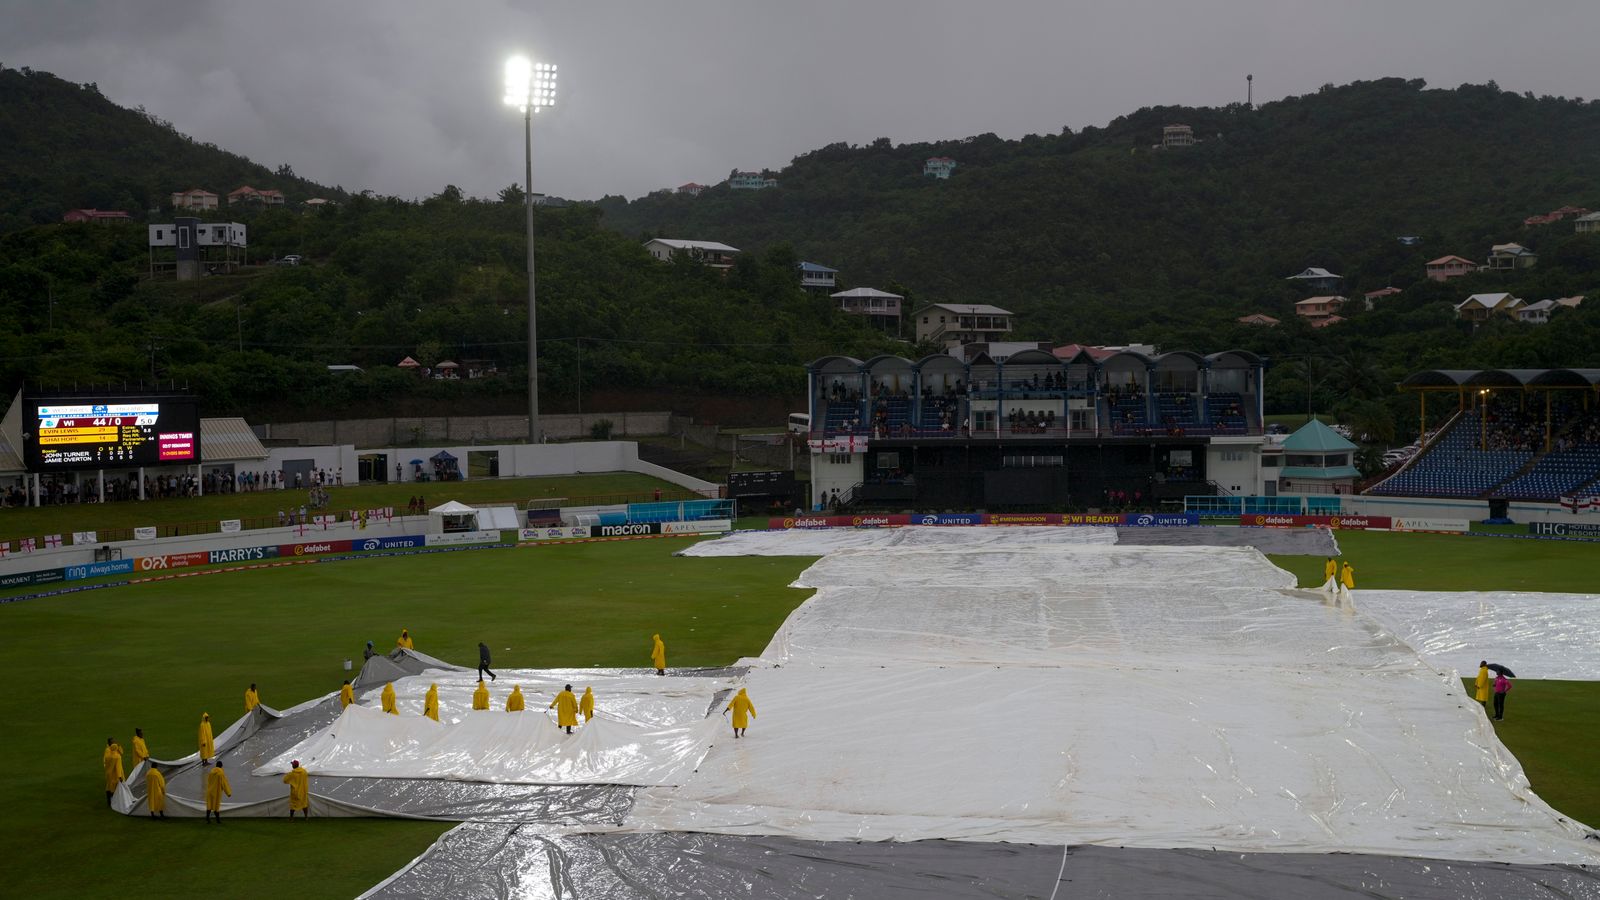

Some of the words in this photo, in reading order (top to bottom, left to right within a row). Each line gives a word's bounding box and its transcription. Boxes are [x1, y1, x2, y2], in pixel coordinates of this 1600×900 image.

[795, 519, 826, 527] dafabet
[1072, 516, 1083, 524] WI
[1086, 516, 1118, 524] READY!
[1266, 516, 1293, 524] dafabet
[1341, 518, 1368, 526] dafabet
[602, 524, 650, 536] macron
[1536, 523, 1565, 535] IHG
[304, 544, 330, 553] dafabet
[210, 547, 263, 563] HARRY'S
[142, 556, 168, 570] OFX
[68, 566, 86, 579] ring
[90, 565, 110, 574] Always
[1, 576, 31, 585] MONUMENT
